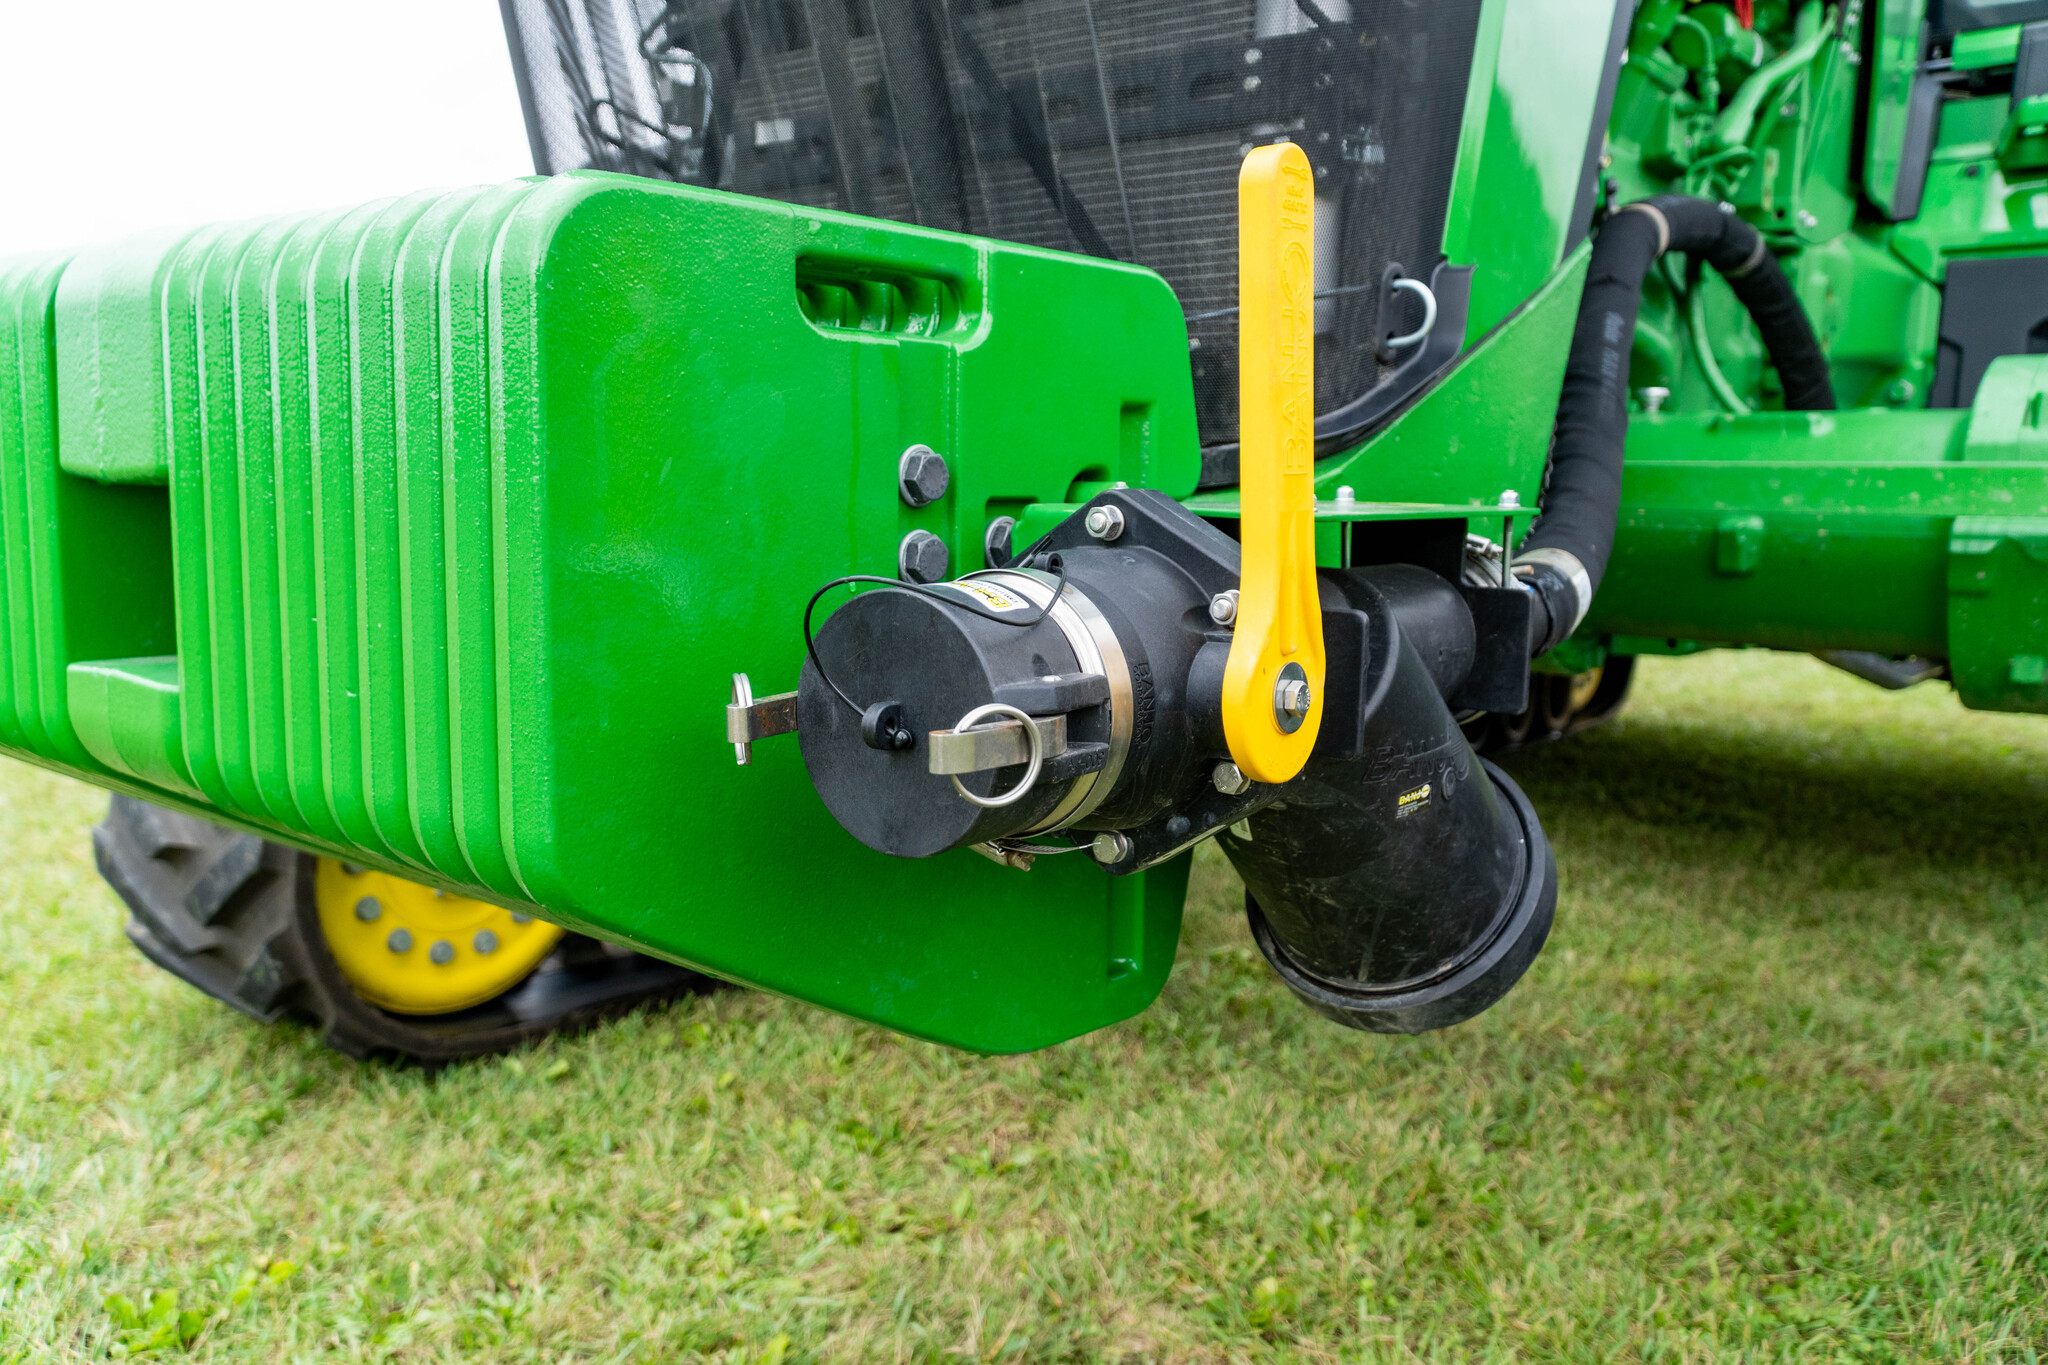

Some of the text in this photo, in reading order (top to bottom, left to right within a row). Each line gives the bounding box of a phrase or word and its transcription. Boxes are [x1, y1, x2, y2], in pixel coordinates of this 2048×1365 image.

[1281, 240, 1309, 475] BANJO
[1133, 665, 1145, 745] CORPORATION
[1138, 662, 1156, 745] BANJO
[1362, 731, 1470, 785] BANJO
[1398, 784, 1431, 806] BANJO
